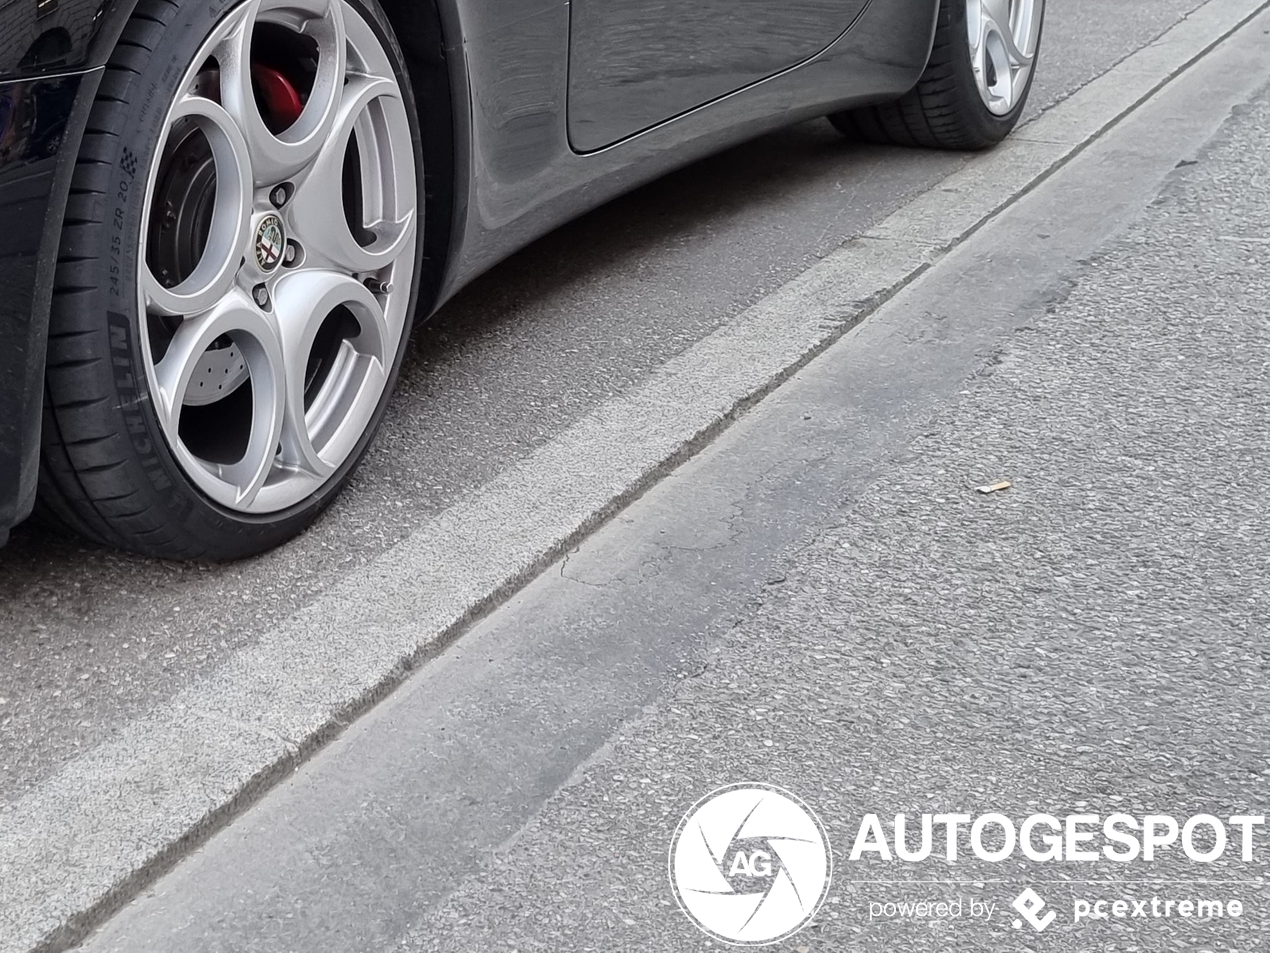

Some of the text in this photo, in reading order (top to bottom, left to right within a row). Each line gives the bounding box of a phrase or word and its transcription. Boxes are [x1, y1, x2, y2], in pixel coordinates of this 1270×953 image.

[109, 180, 129, 296] 245/35 ZR 20
